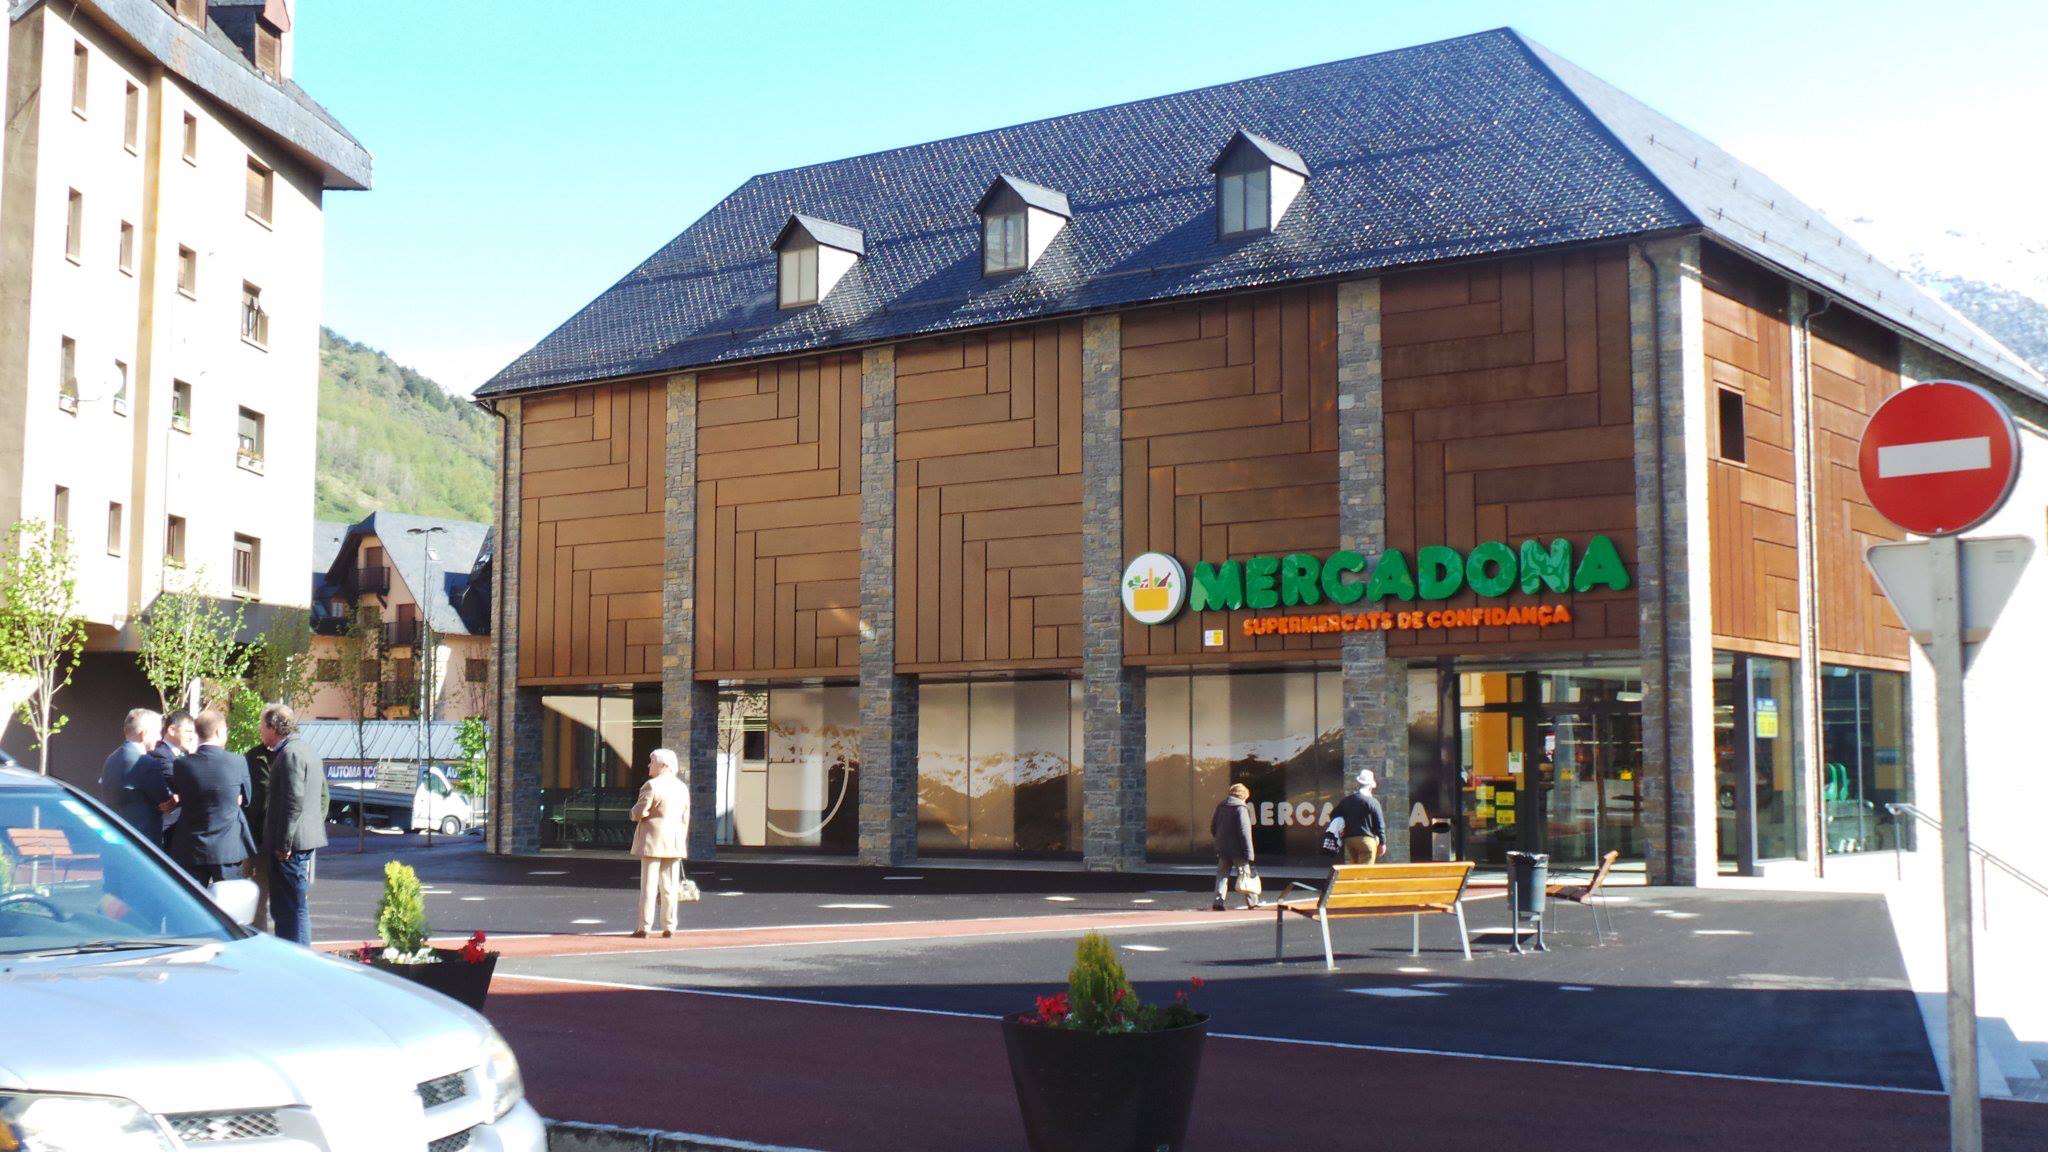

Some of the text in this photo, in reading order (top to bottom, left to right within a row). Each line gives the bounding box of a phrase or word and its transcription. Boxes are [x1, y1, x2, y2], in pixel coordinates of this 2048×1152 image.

[1190, 534, 1630, 612] MERCADONA
[1243, 604, 1571, 636] SUPERMERCATS DE CONFIDANÇA
